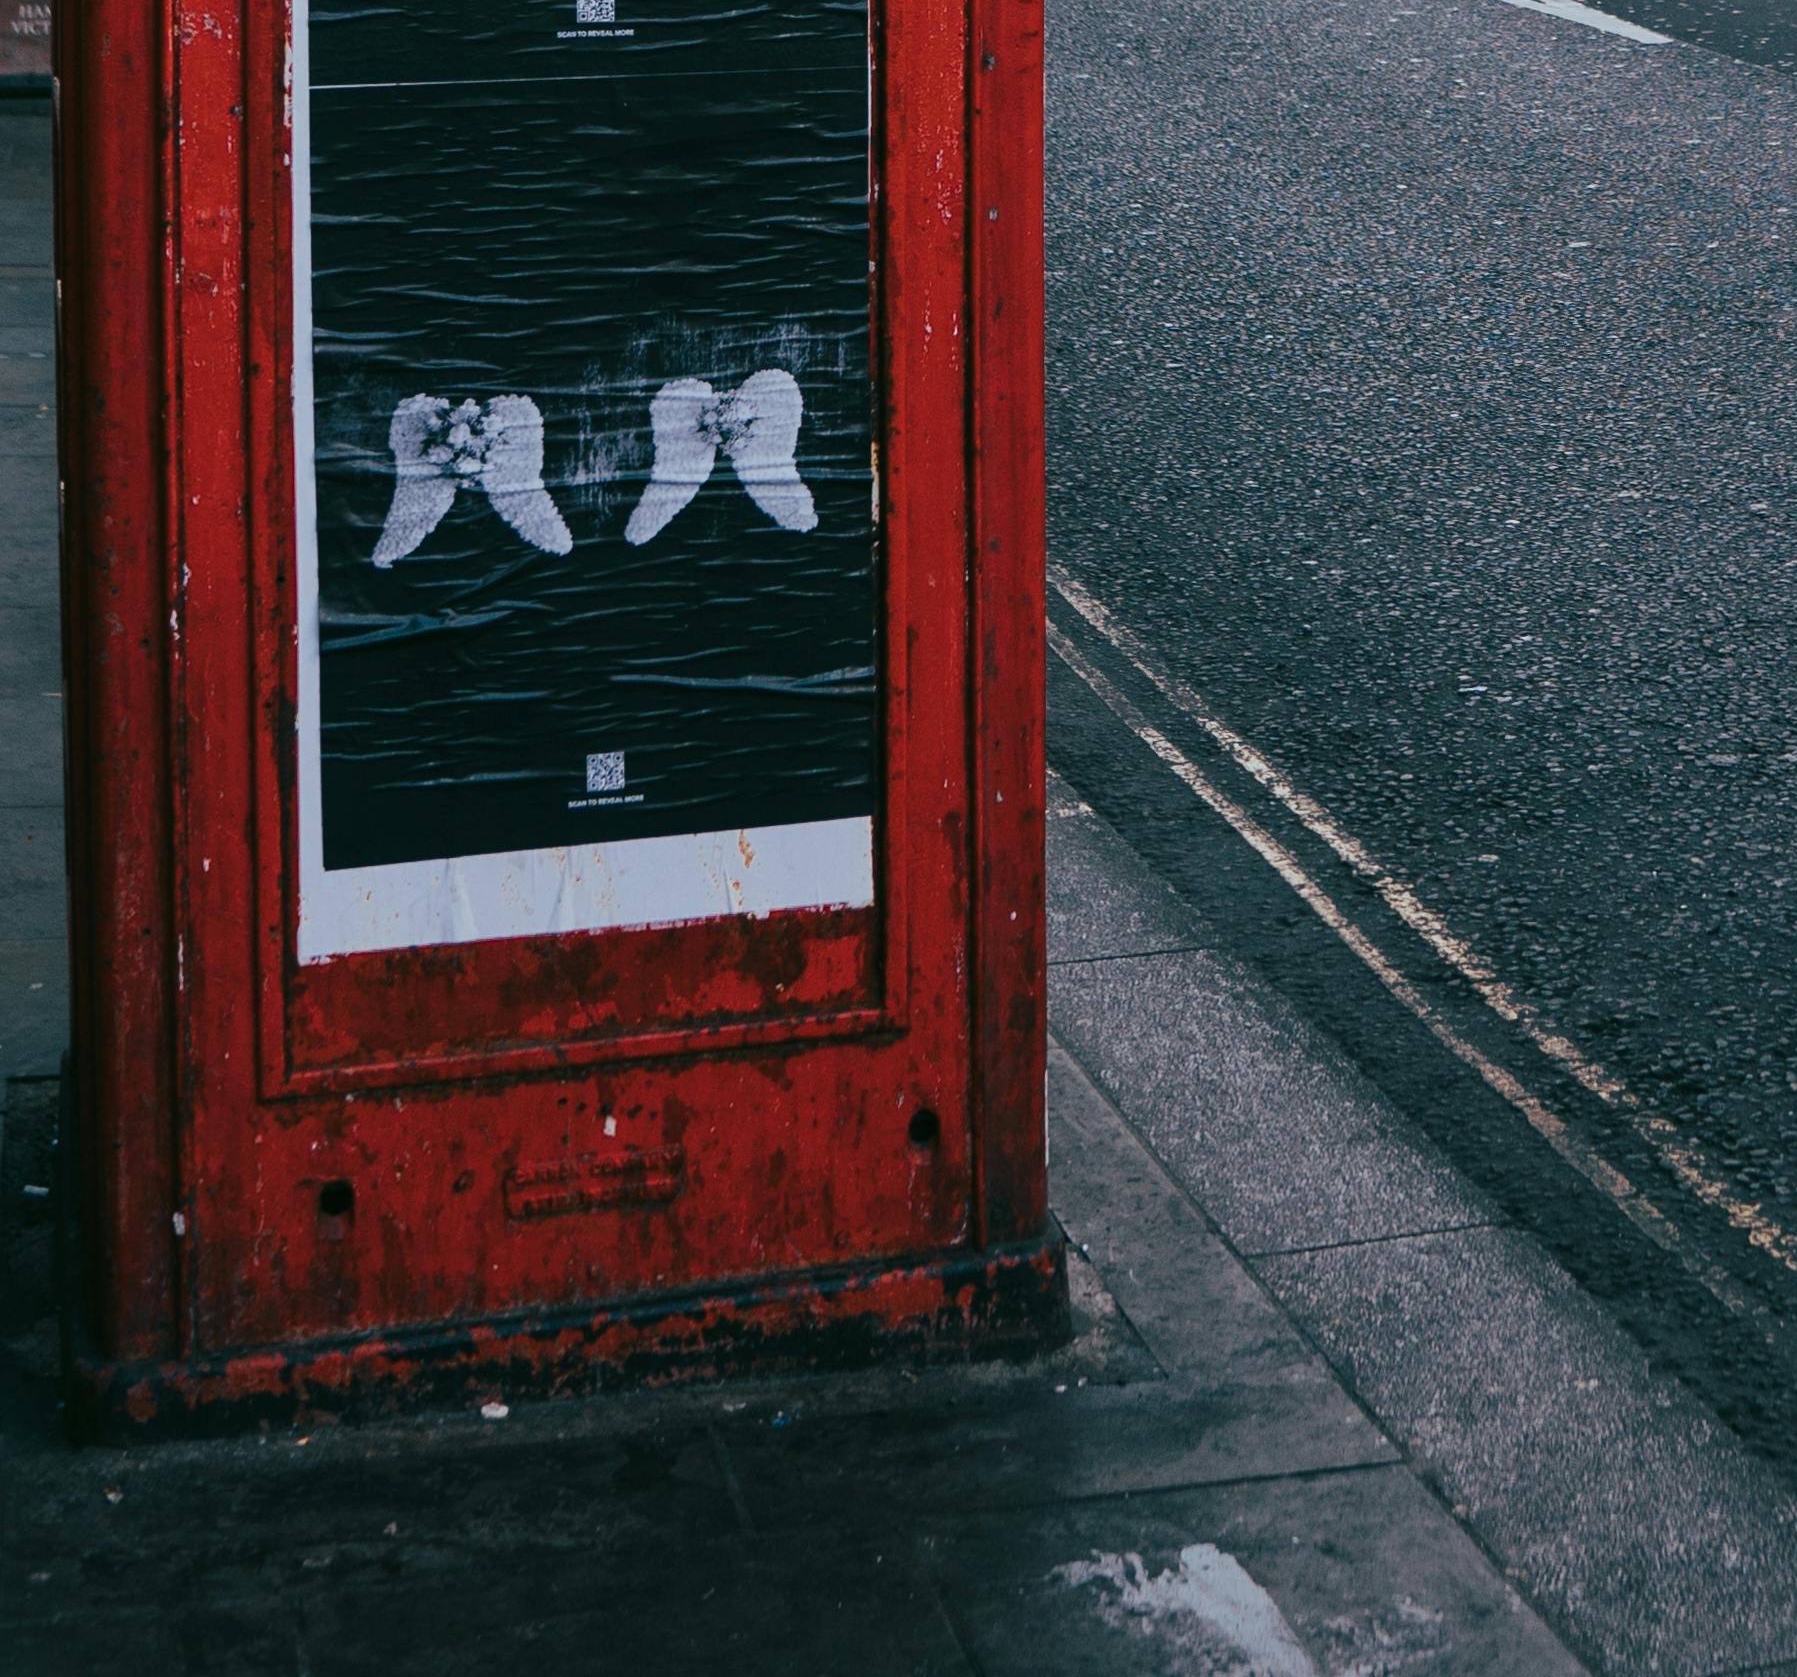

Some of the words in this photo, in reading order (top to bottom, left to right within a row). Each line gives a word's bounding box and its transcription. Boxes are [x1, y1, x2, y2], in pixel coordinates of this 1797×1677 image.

[587, 29, 614, 37] REVEAL
[614, 28, 635, 36] MORE
[568, 799, 587, 809] SCAN
[598, 797, 624, 805] REVEAL
[624, 793, 645, 803] MORE
